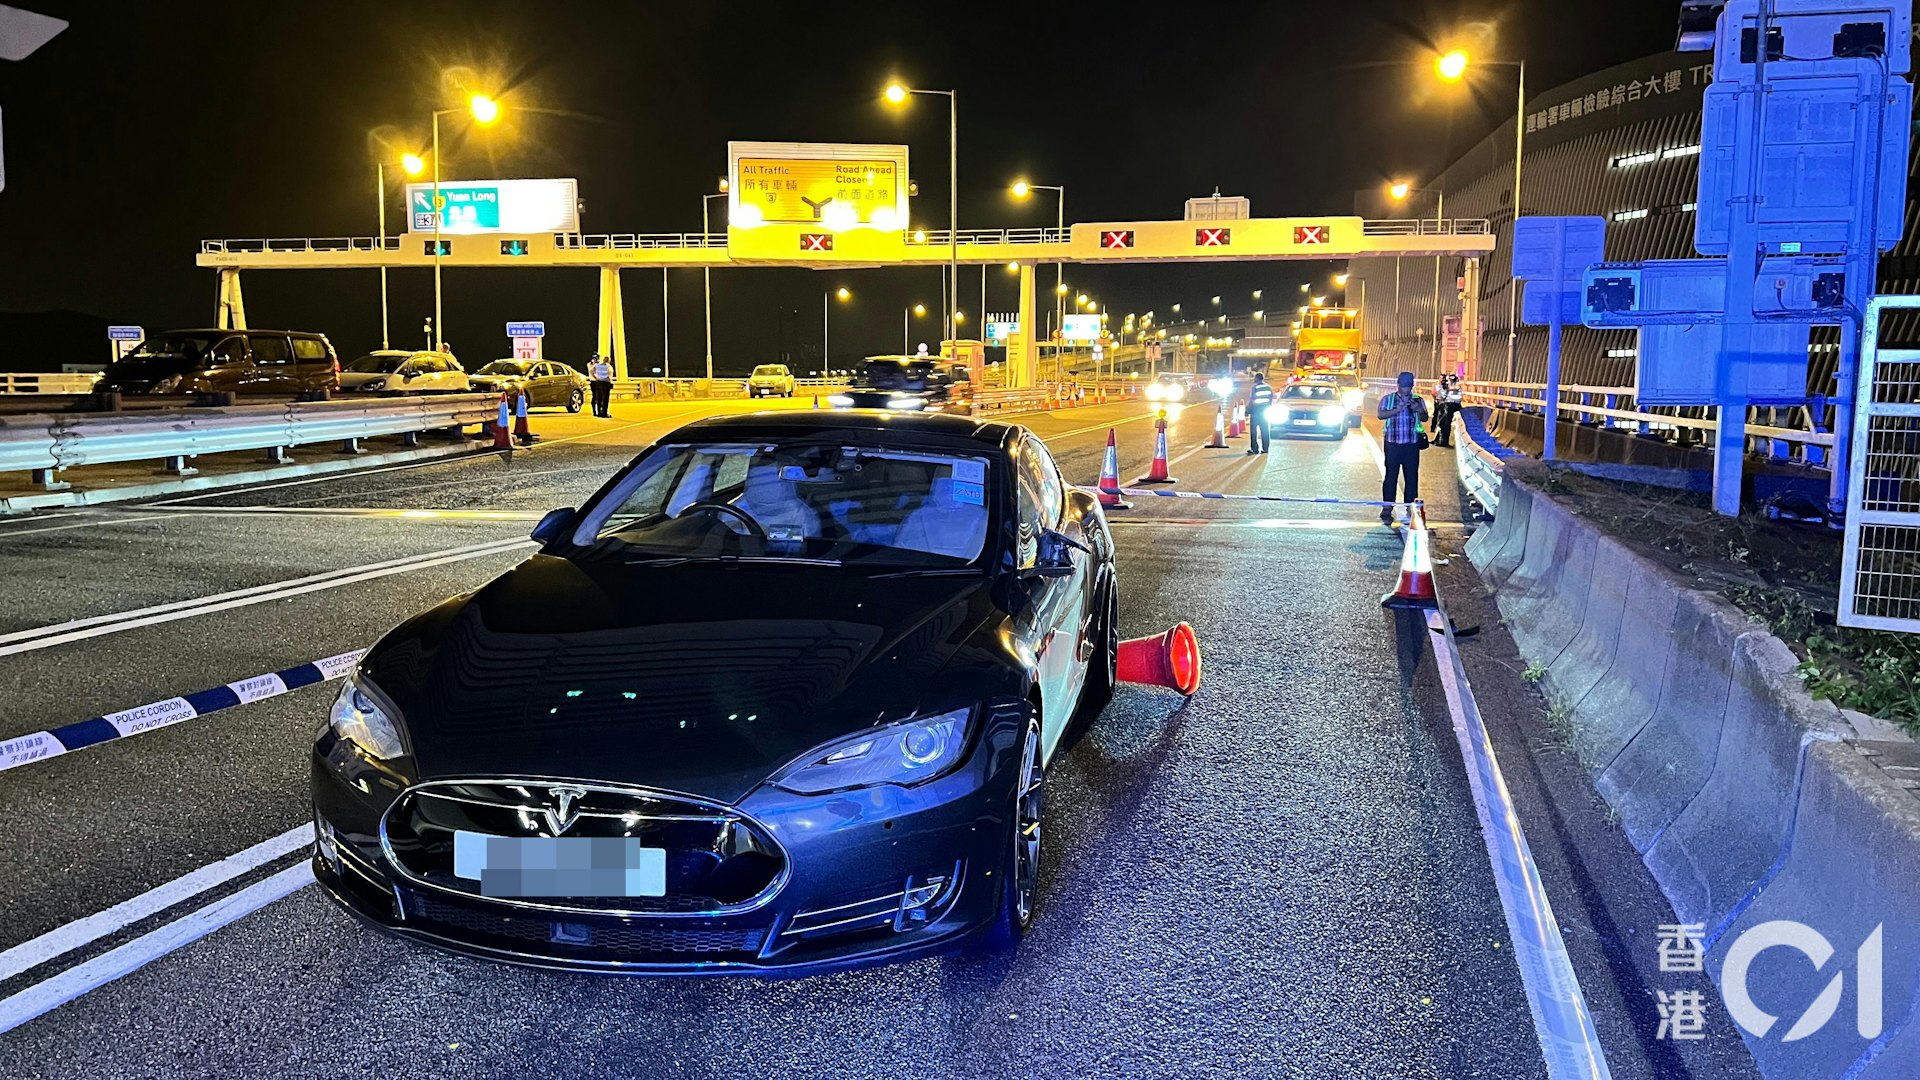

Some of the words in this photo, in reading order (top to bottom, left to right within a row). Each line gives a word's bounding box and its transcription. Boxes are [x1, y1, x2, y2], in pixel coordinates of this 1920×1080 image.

[1526, 69, 1682, 134] 運輸署車輛檢驗綜合大樓
[743, 166, 756, 175] All
[759, 166, 790, 175] Traffic
[836, 165, 860, 174] Road
[863, 166, 892, 174] Ahead
[744, 179, 798, 191] 所有車輛
[446, 191, 471, 202] Yuan
[472, 191, 496, 203] Long
[768, 194, 775, 202] 3
[321, 657, 343, 669] POLICE
[343, 652, 363, 664] CORD
[115, 709, 147, 725] POLICE
[130, 723, 144, 733] DO
[144, 717, 163, 730] NOT
[164, 710, 192, 724] CROSS
